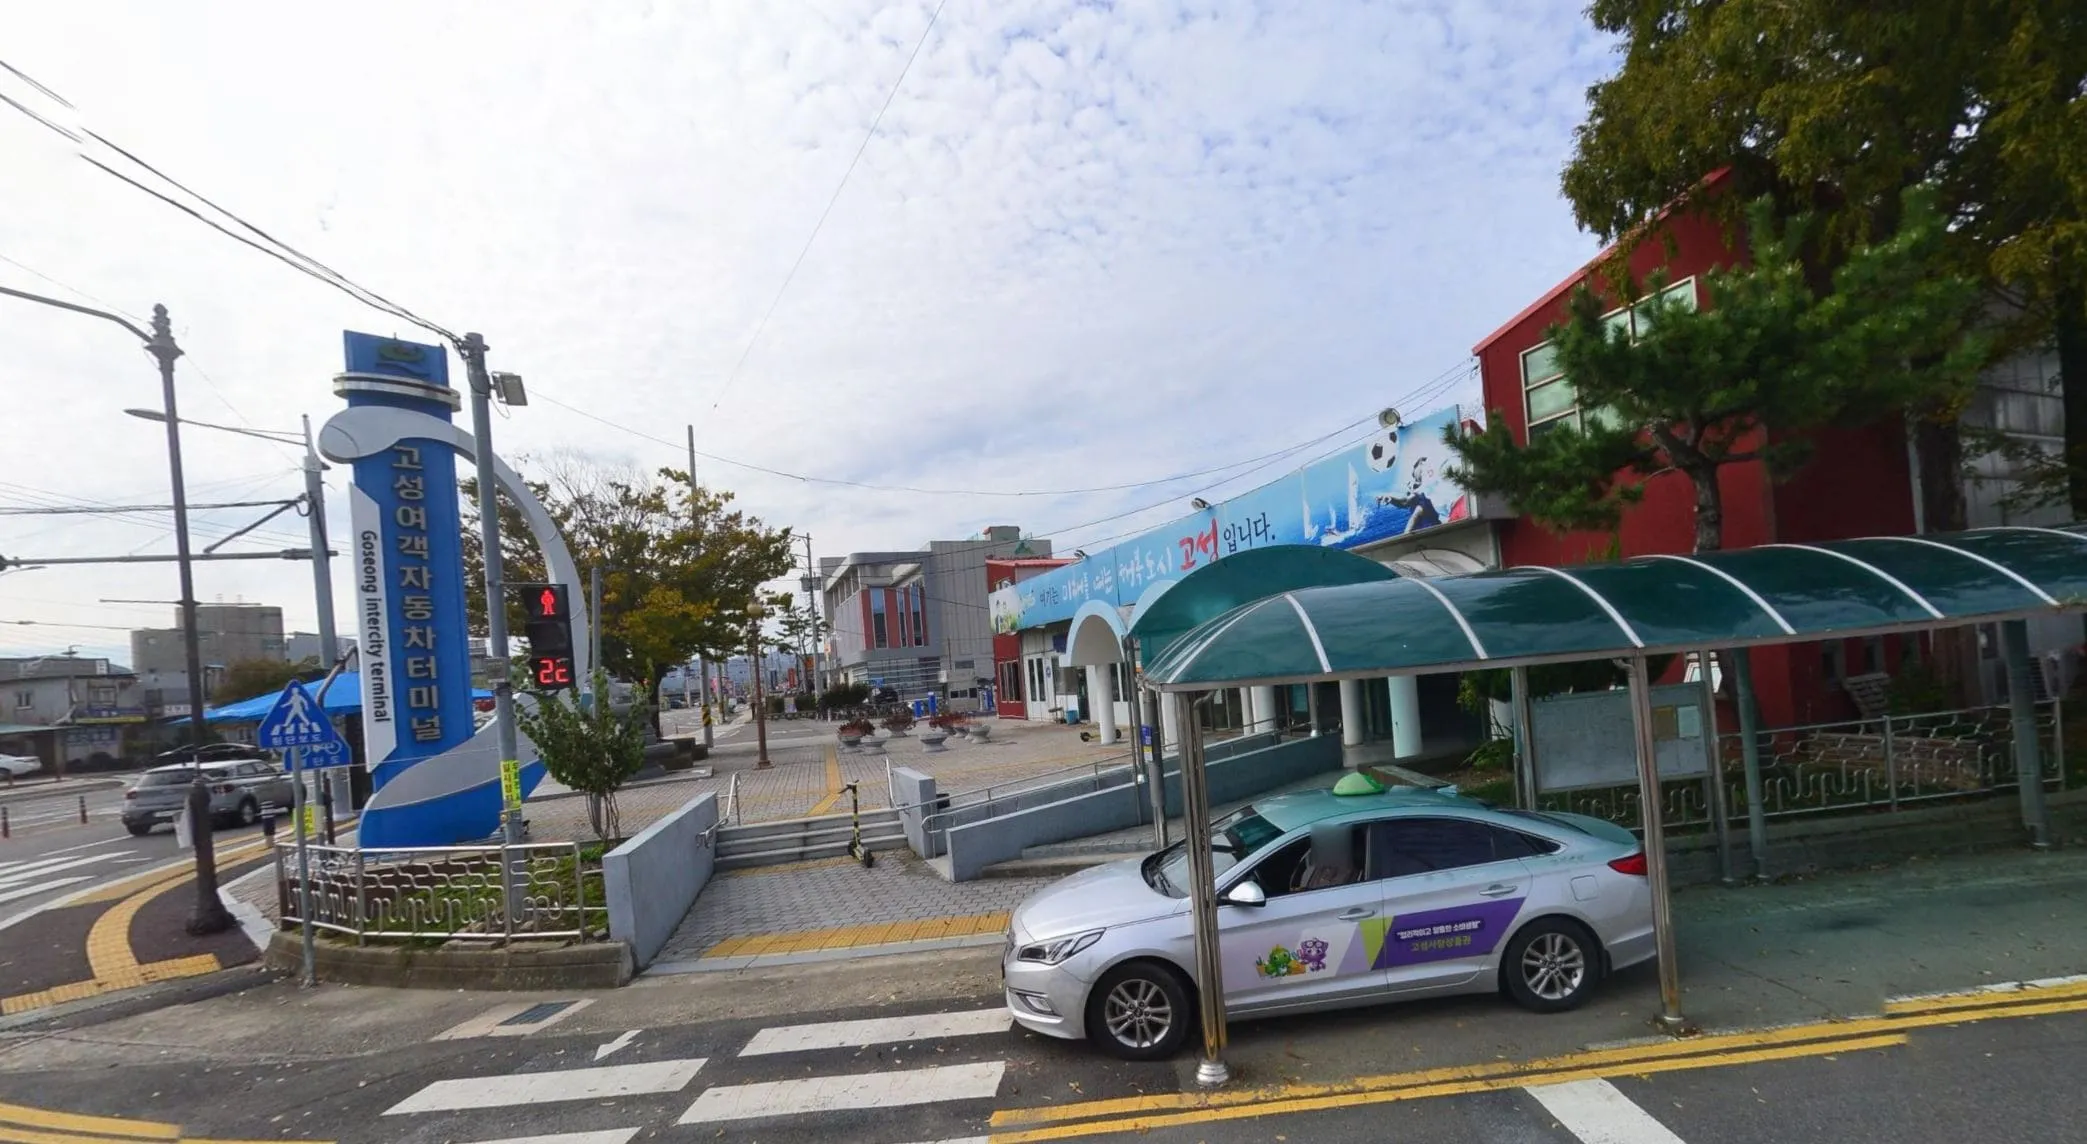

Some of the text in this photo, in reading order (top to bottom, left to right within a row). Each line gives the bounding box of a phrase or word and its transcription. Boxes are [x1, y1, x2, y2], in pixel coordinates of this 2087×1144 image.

[361, 530, 390, 722] Goseong intercity terminal
[391, 444, 442, 741] 고성여객자동차터미널
[1179, 517, 1219, 571] 고성
